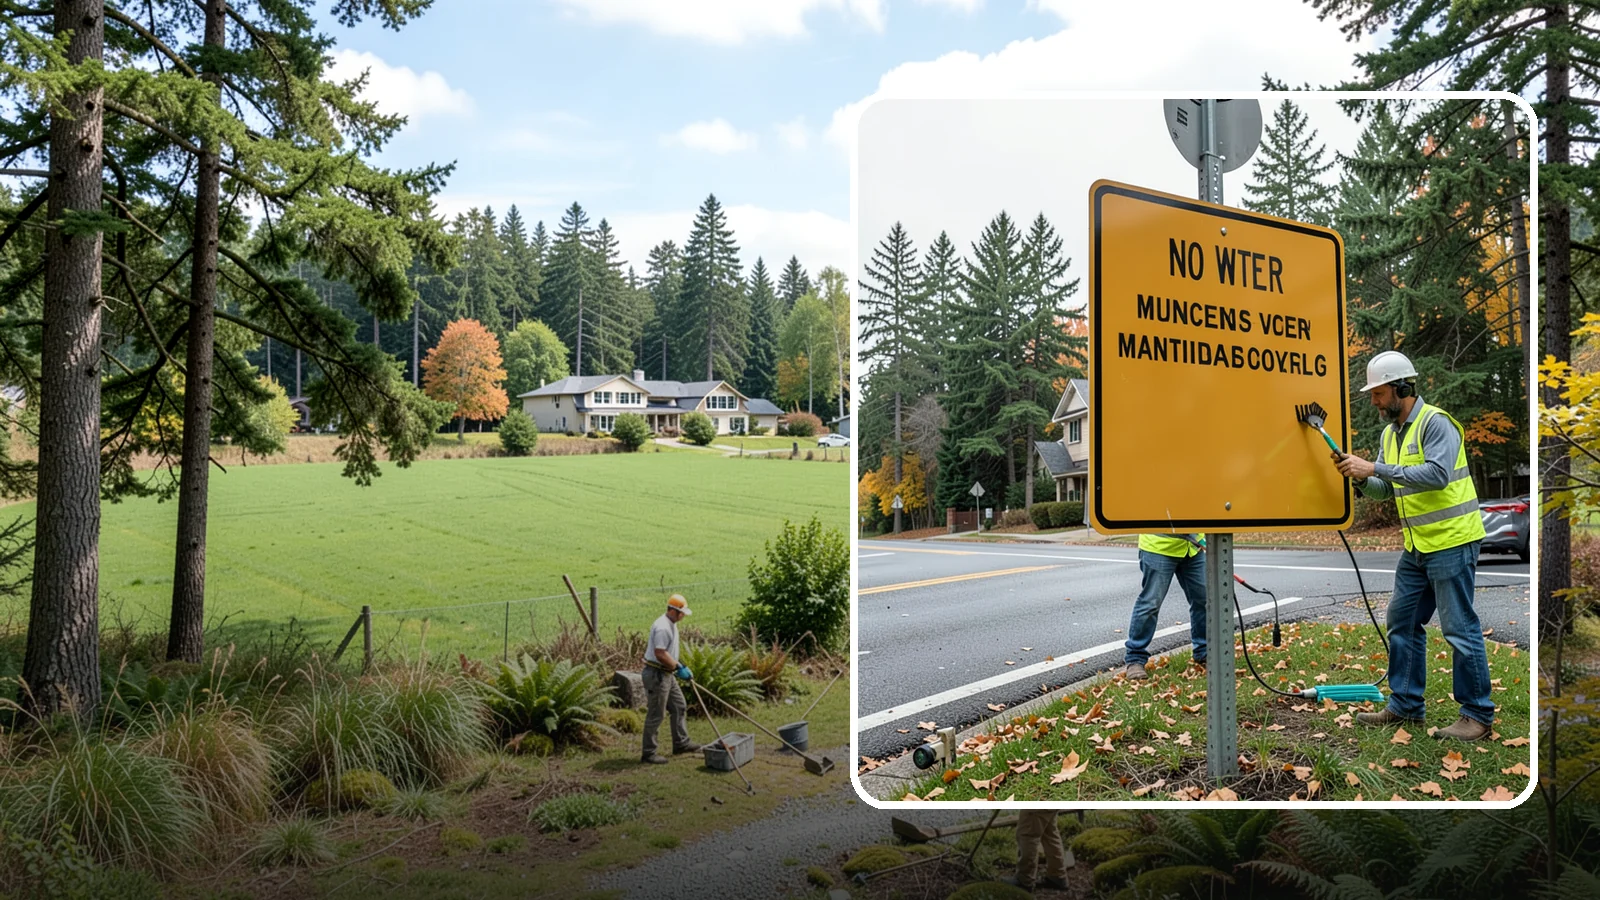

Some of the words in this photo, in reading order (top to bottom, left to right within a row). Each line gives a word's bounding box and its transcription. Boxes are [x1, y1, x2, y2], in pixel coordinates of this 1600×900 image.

[1169, 238, 1204, 281] NO
[1215, 245, 1284, 294] WTER
[1137, 294, 1252, 333] MUNCENS
